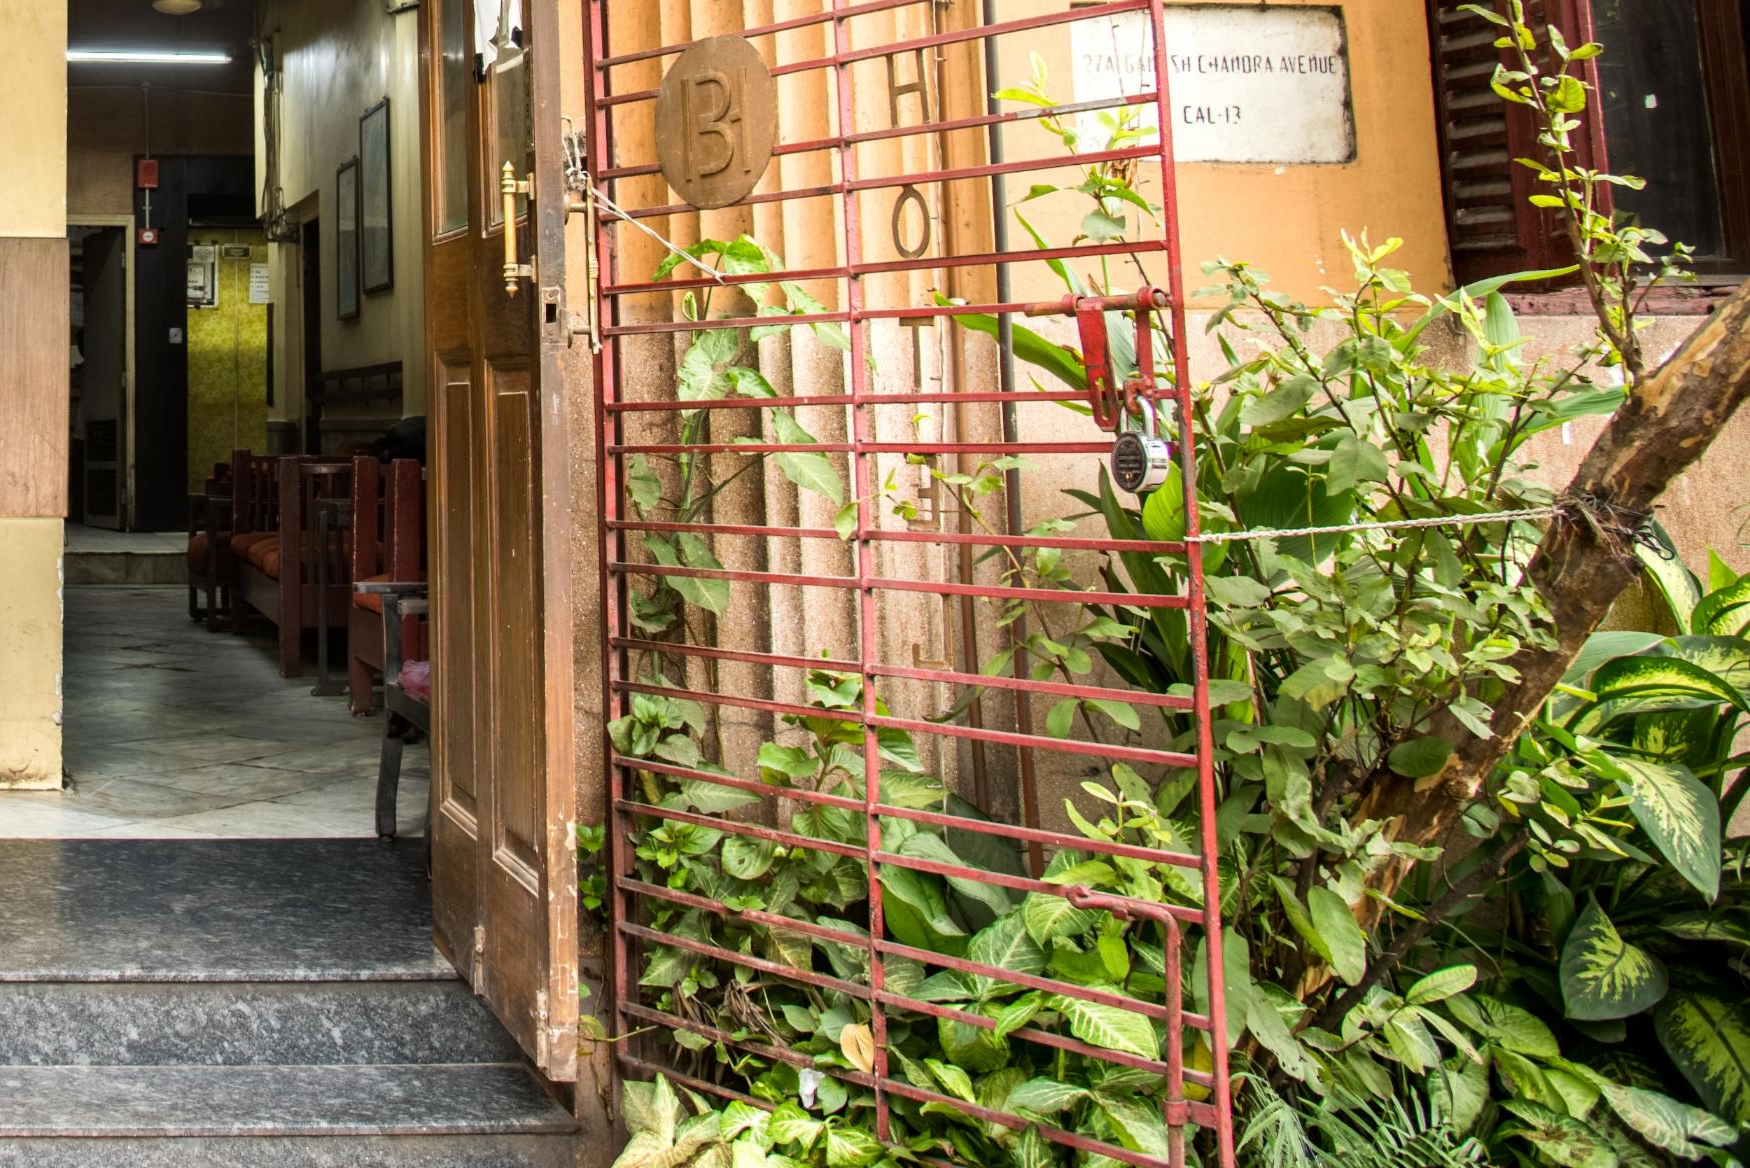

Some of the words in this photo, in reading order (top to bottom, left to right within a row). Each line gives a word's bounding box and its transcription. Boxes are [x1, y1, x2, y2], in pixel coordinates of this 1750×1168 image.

[1124, 54, 1192, 74] GANSH
[1198, 54, 1274, 74] CHANDRA
[1279, 54, 1338, 75] AVENUE
